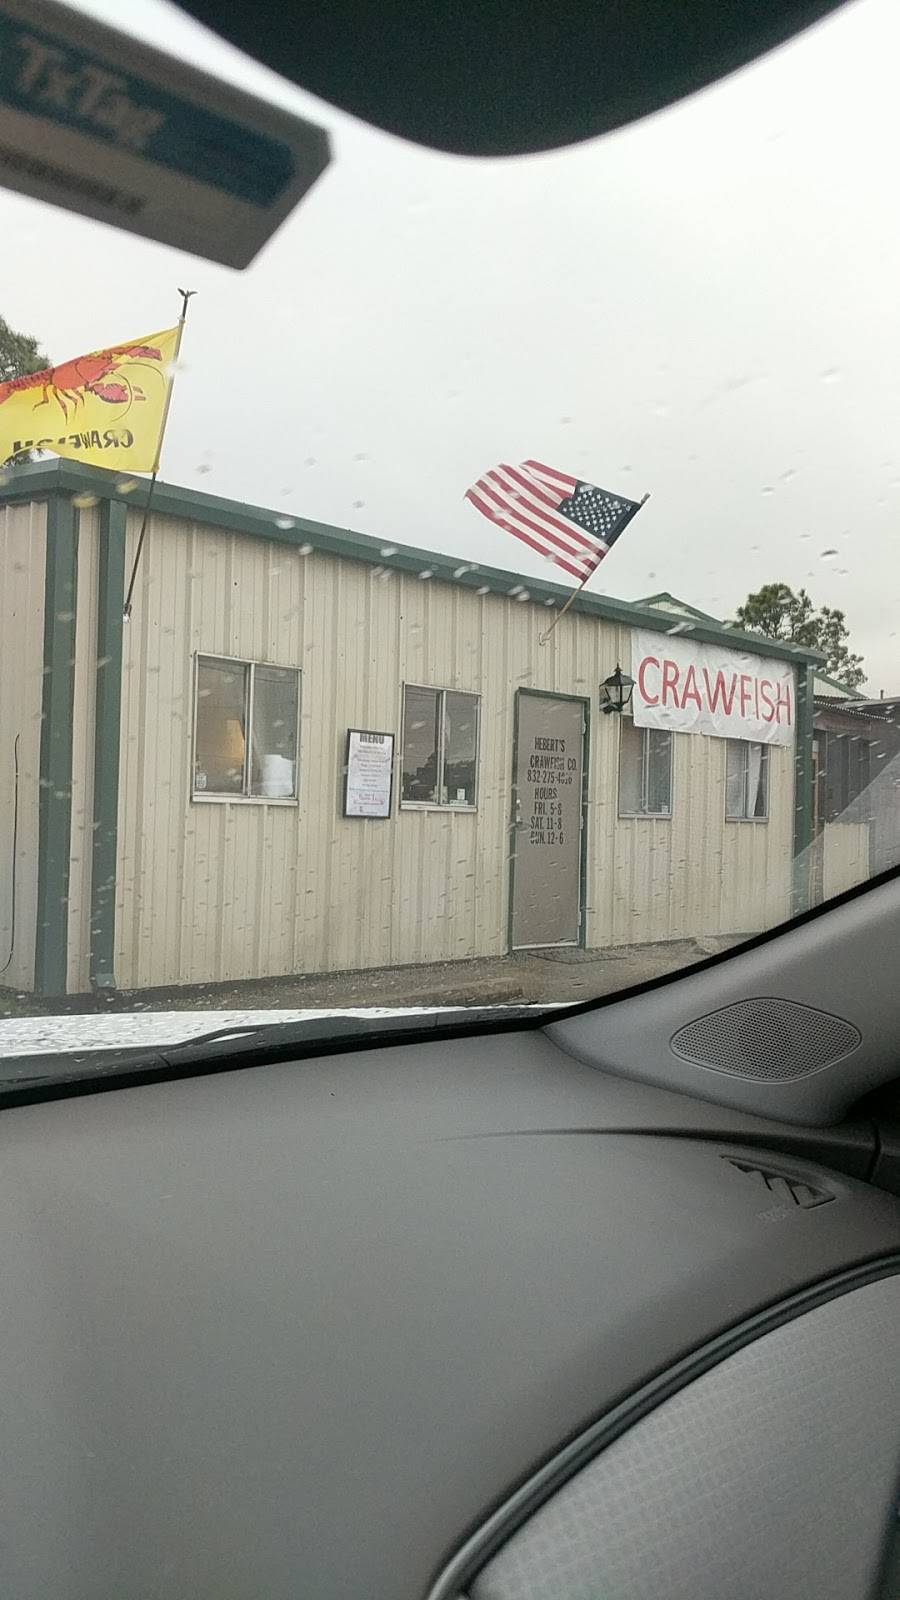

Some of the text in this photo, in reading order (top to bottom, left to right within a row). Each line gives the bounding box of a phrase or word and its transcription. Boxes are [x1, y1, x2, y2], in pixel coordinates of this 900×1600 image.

[638, 655, 792, 726] CRAWFISH
[360, 732, 384, 744] MENU
[535, 737, 565, 752] HEBERT'S
[530, 755, 564, 769] CRAWFISH
[550, 802, 562, 816] 5-8
[546, 817, 562, 831] 11-8
